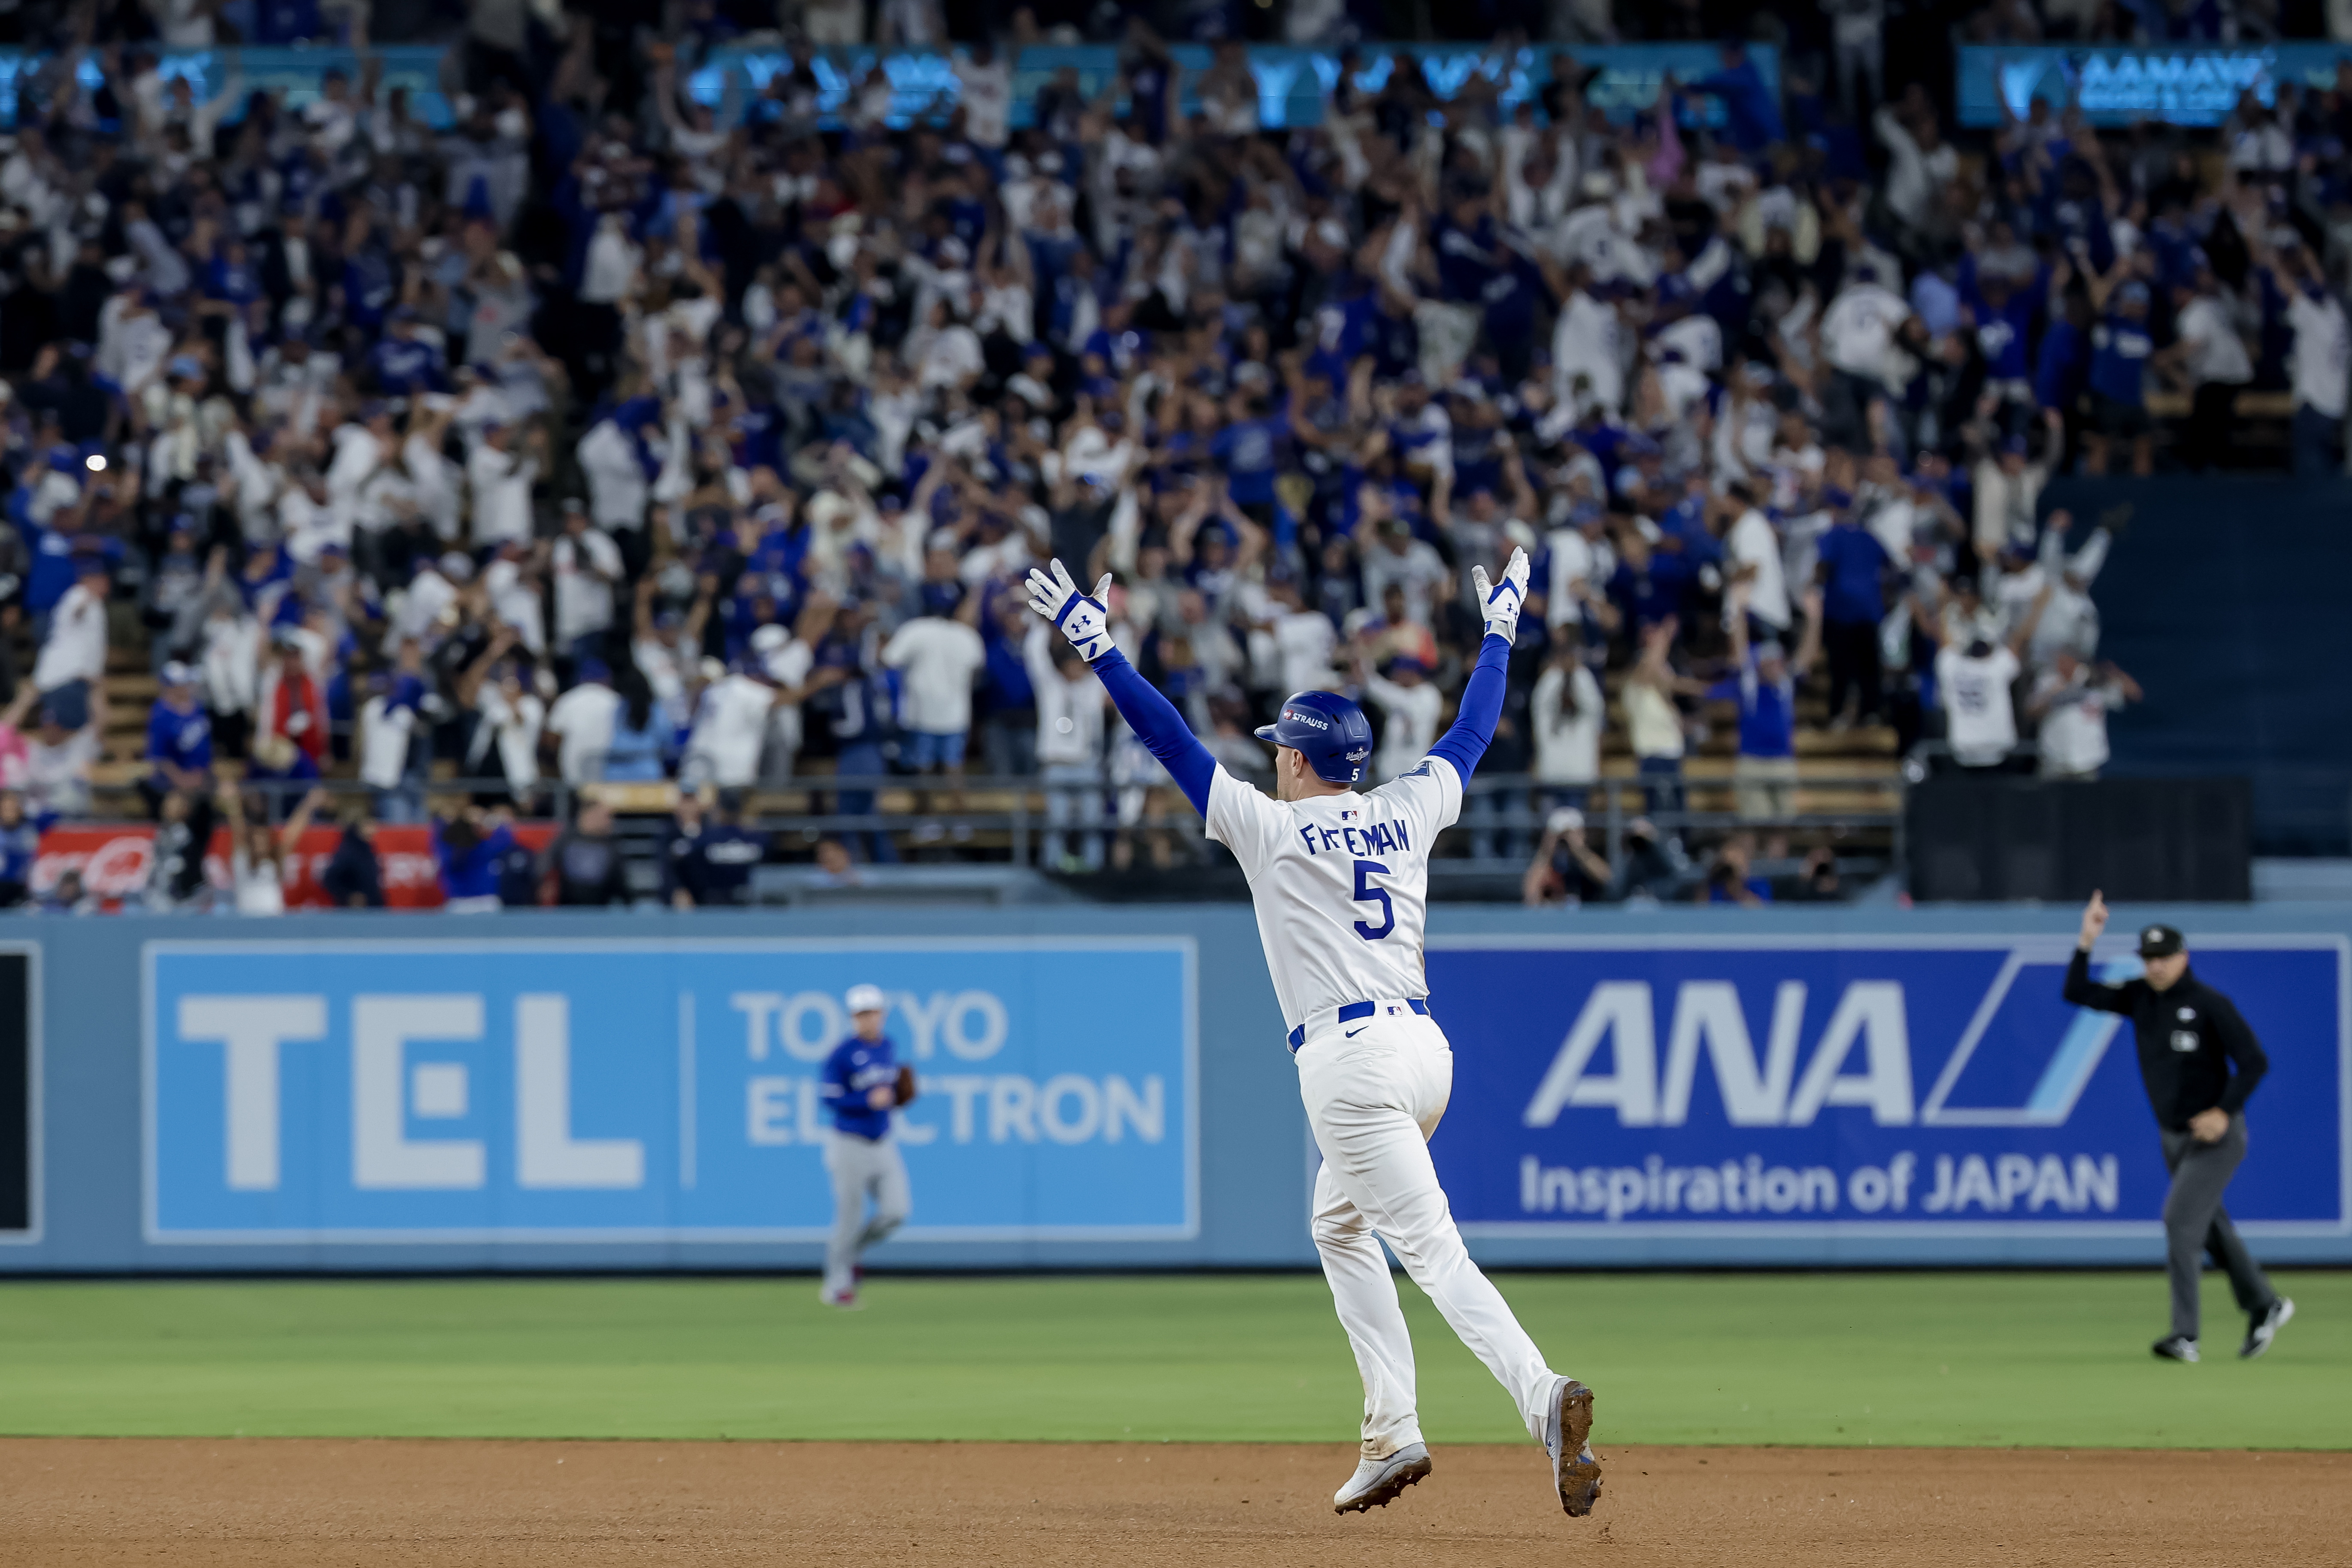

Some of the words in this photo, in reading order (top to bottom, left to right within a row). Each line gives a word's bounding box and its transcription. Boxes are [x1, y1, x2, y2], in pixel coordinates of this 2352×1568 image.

[1292, 713, 1328, 730] STRAUSS
[1351, 768, 1360, 781] 5
[1353, 860, 1395, 940] 5
[730, 990, 1009, 1061] TOYO
[1523, 980, 1916, 1128] ANA
[178, 994, 645, 1189] TEL
[747, 1074, 1165, 1145] ELCTRON
[1520, 1154, 1837, 1221] Inspiration
[1848, 1152, 1916, 1213] of
[1923, 1155, 2119, 1213] JAPAN
